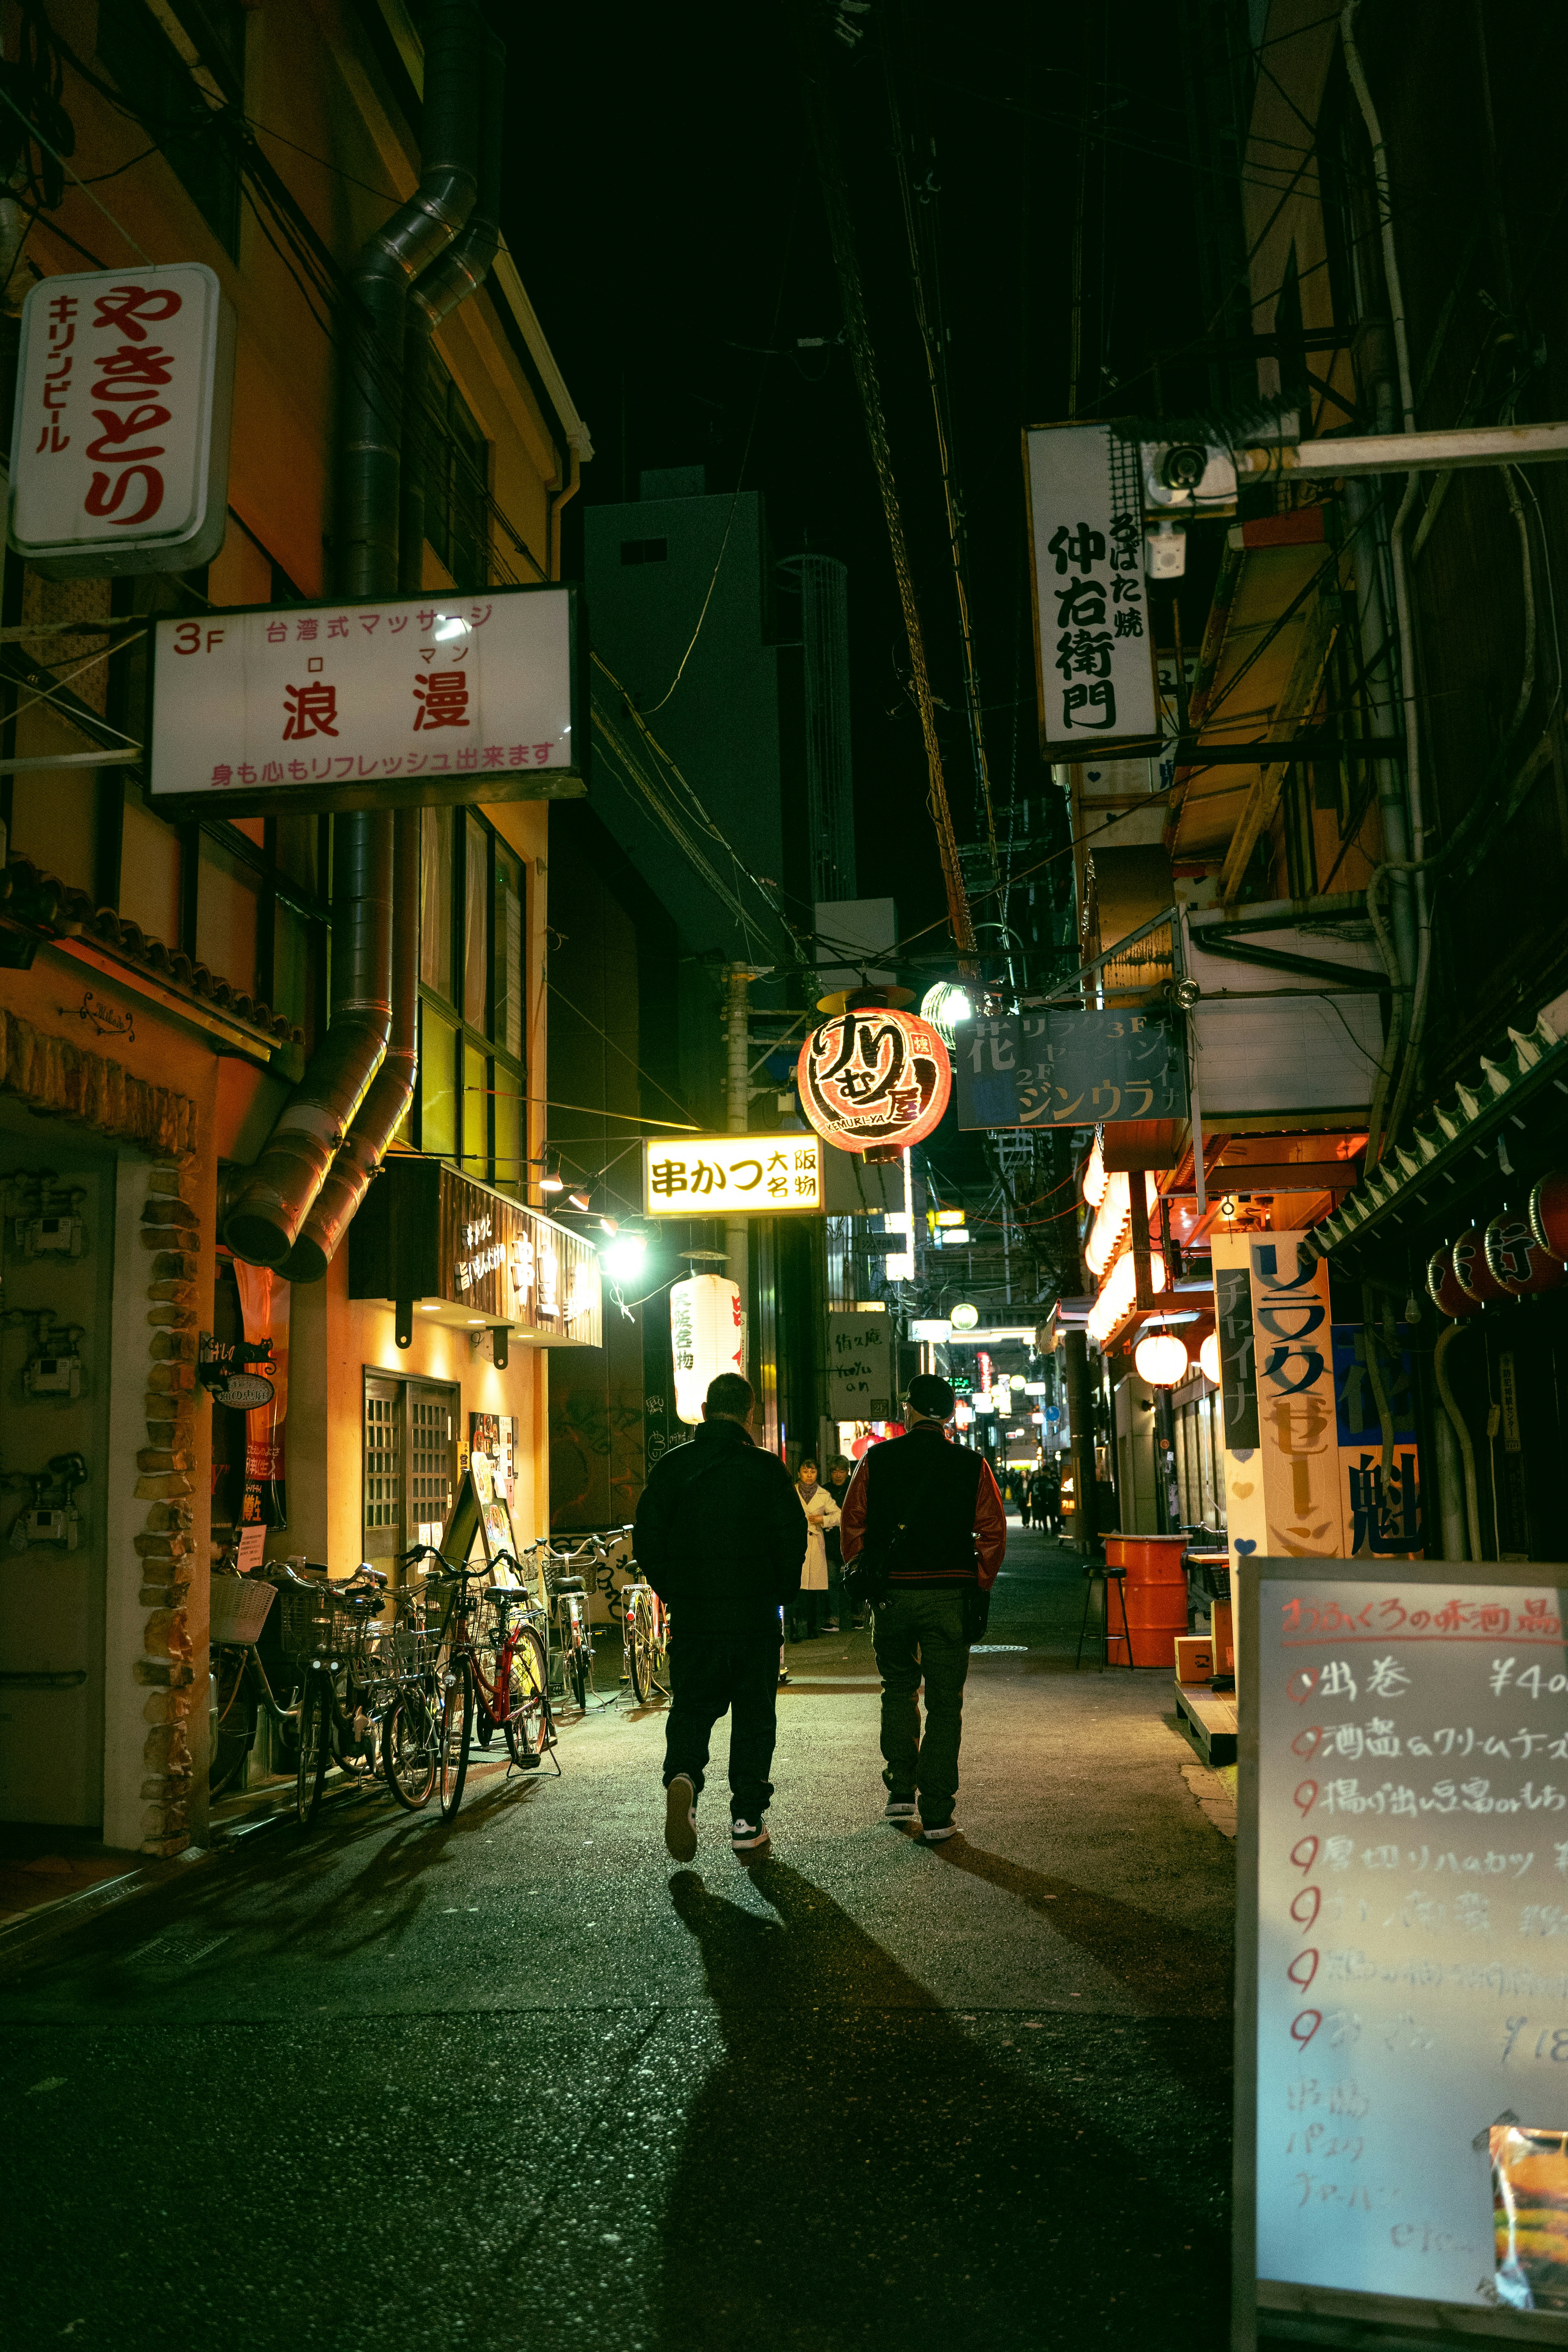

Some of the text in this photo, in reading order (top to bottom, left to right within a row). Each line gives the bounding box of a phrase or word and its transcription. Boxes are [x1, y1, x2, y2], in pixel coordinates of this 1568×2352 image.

[36, 294, 78, 454] キリンビール
[84, 285, 183, 526] やきとり
[1109, 512, 1143, 639] ろばた焼
[172, 622, 225, 655] 3F
[266, 604, 492, 644] 台湾式マッサージ
[1048, 522, 1117, 730] 仲右衛門
[210, 741, 555, 788] 身も心もリフレッシュ出来ます
[1107, 1016, 1147, 1038] 3F
[967, 1022, 1016, 1073] 花
[1016, 1063, 1055, 1085] 2F
[1019, 1079, 1154, 1123] ジンウラ
[826, 1114, 885, 1132] KEMURI-YA
[652, 1159, 763, 1197] 串かつ
[767, 1149, 816, 1171] 大阪
[767, 1176, 816, 1198] 名物
[675, 1291, 694, 1371] 大阪名物
[1216, 1274, 1258, 1426] チャイナ
[846, 1381, 869, 1392] an
[874, 1404, 886, 1412] 2F
